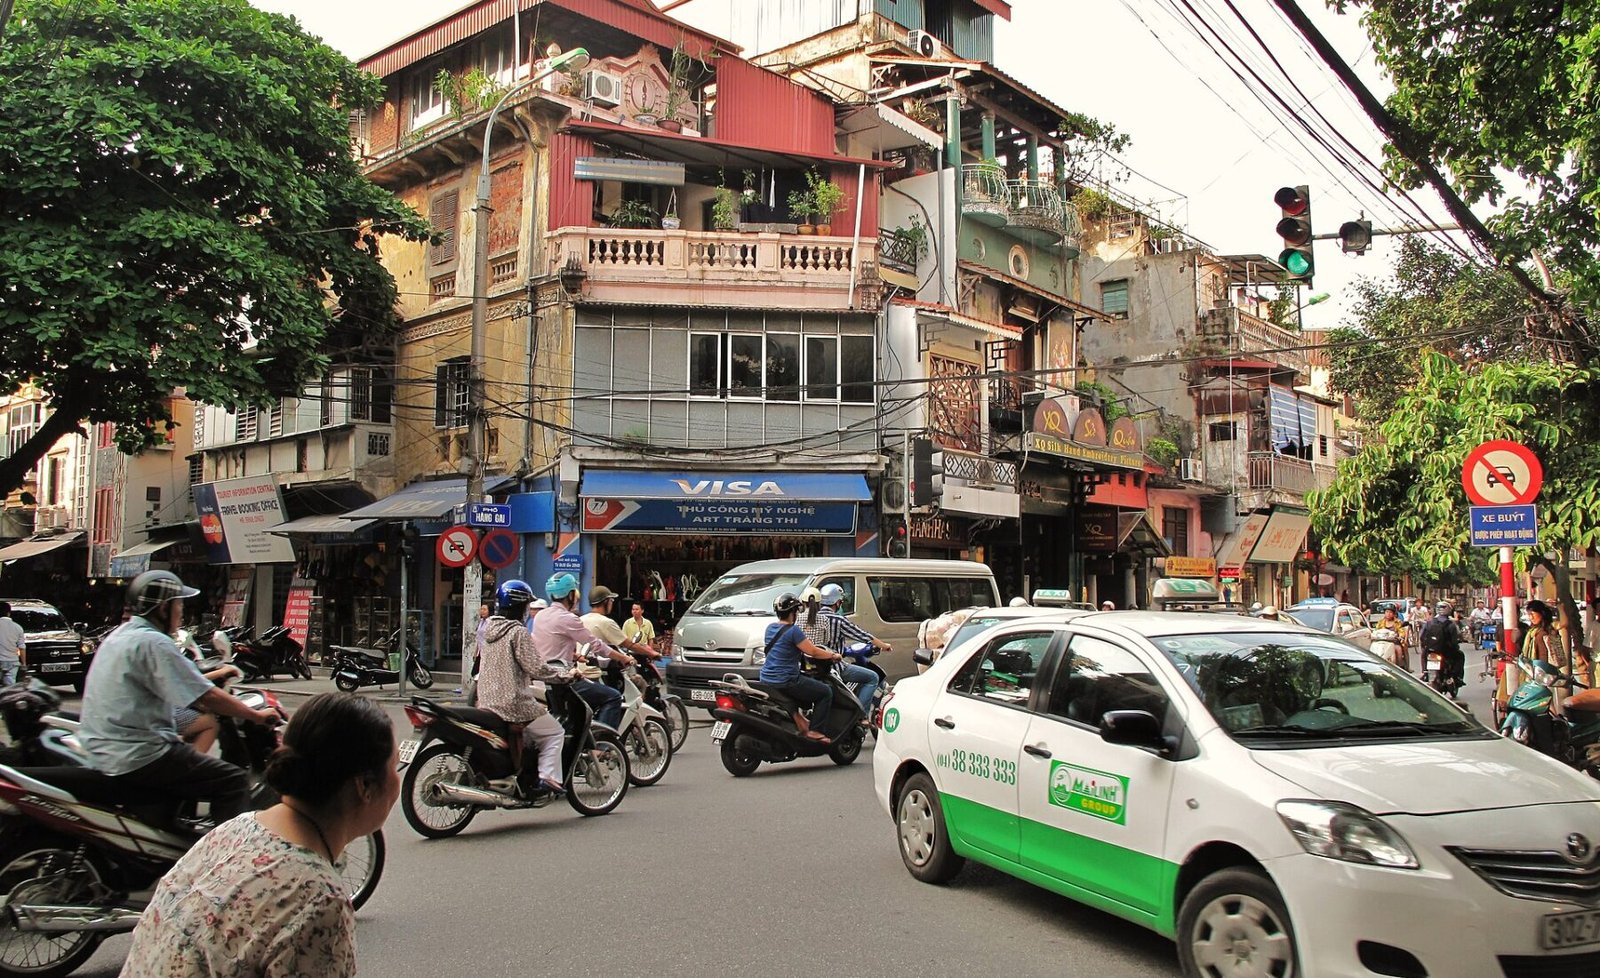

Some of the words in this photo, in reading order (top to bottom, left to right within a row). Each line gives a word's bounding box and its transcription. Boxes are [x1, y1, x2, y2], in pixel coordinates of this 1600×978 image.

[1042, 410, 1066, 435] XQ
[1035, 438, 1046, 451] XQ
[1047, 440, 1061, 452] Silk
[1064, 443, 1081, 456] Hand
[669, 479, 784, 495] VISA
[238, 501, 261, 514] BOOKING
[260, 499, 279, 512] OFFICE
[707, 505, 749, 514] CÔNG
[494, 513, 505, 523] GAI
[1481, 514, 1496, 523] XE
[1497, 511, 1525, 522] BUÝT
[1084, 523, 1105, 536] XQ
[1489, 528, 1504, 539] PHÉP
[937, 752, 951, 768] (04)
[952, 748, 966, 773] 38
[969, 752, 990, 779] 333
[993, 757, 1016, 786] 333
[1081, 798, 1116, 815] GROUP
